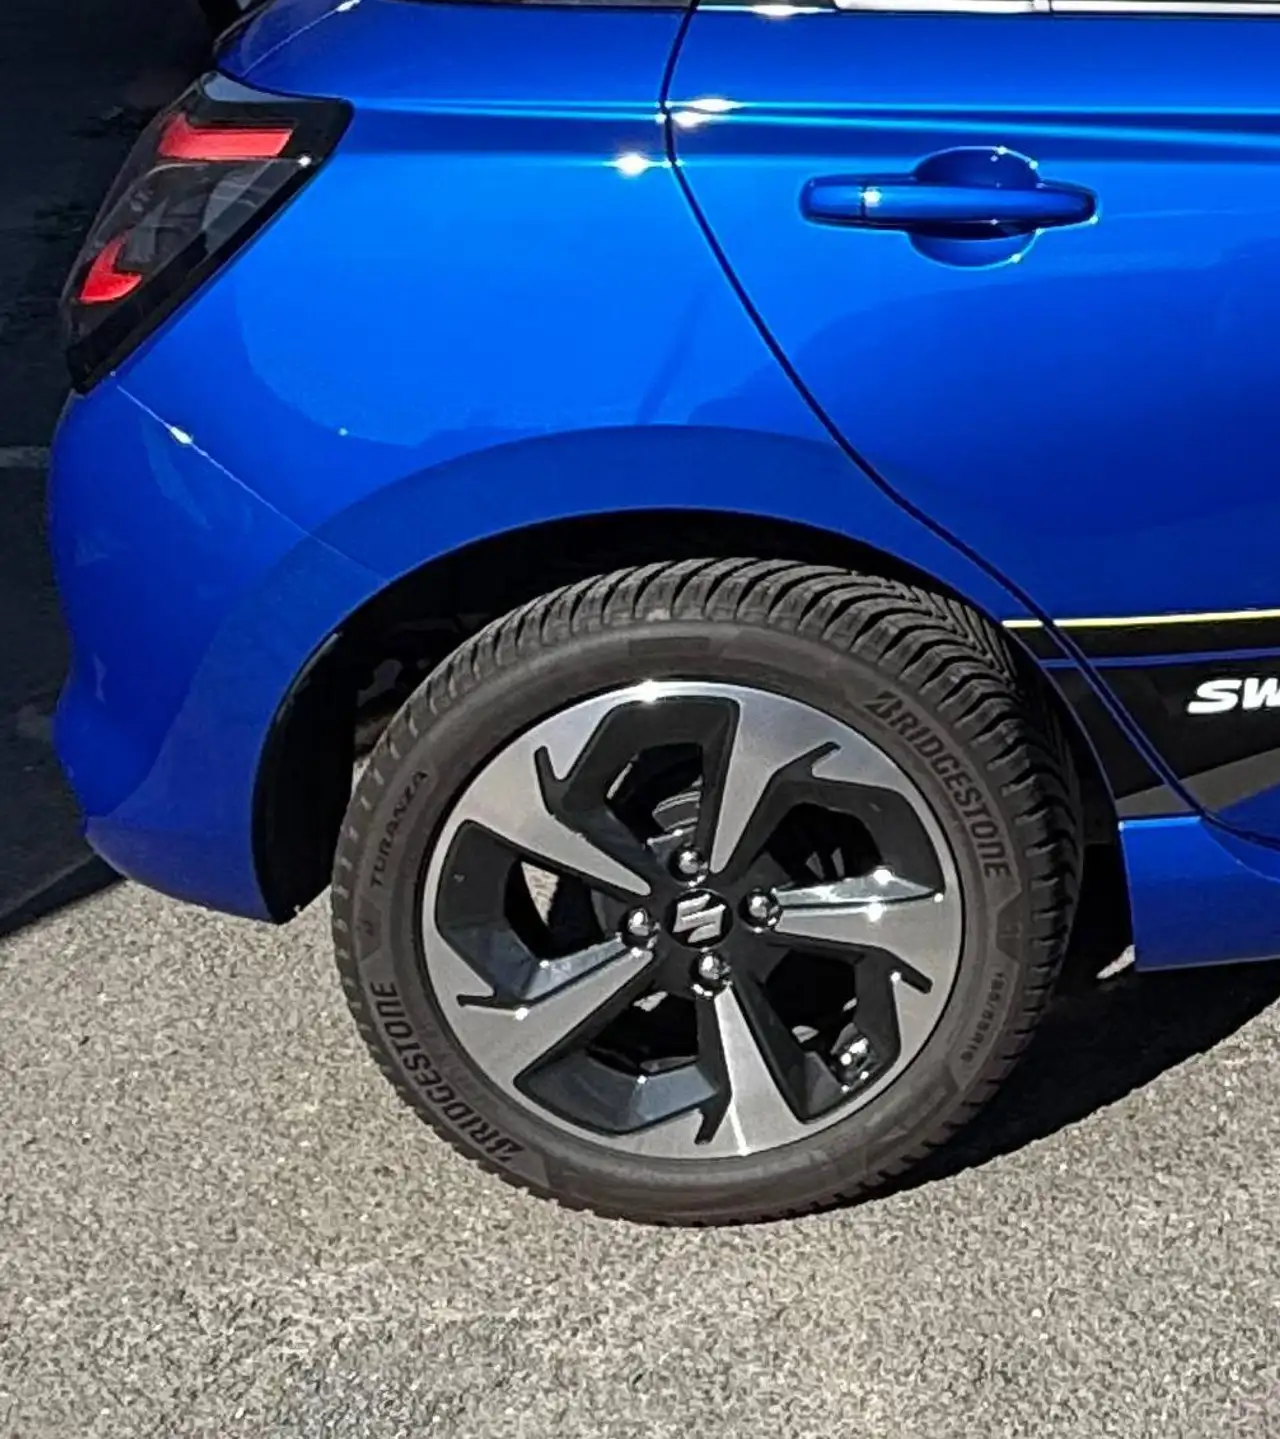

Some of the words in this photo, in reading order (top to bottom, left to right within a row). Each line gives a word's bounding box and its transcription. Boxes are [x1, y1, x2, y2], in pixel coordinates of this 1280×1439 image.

[369, 770, 429, 888] TURANZA
[863, 690, 1010, 879] BRIDGESTONE
[369, 981, 525, 1162] BRIDGESTONE
